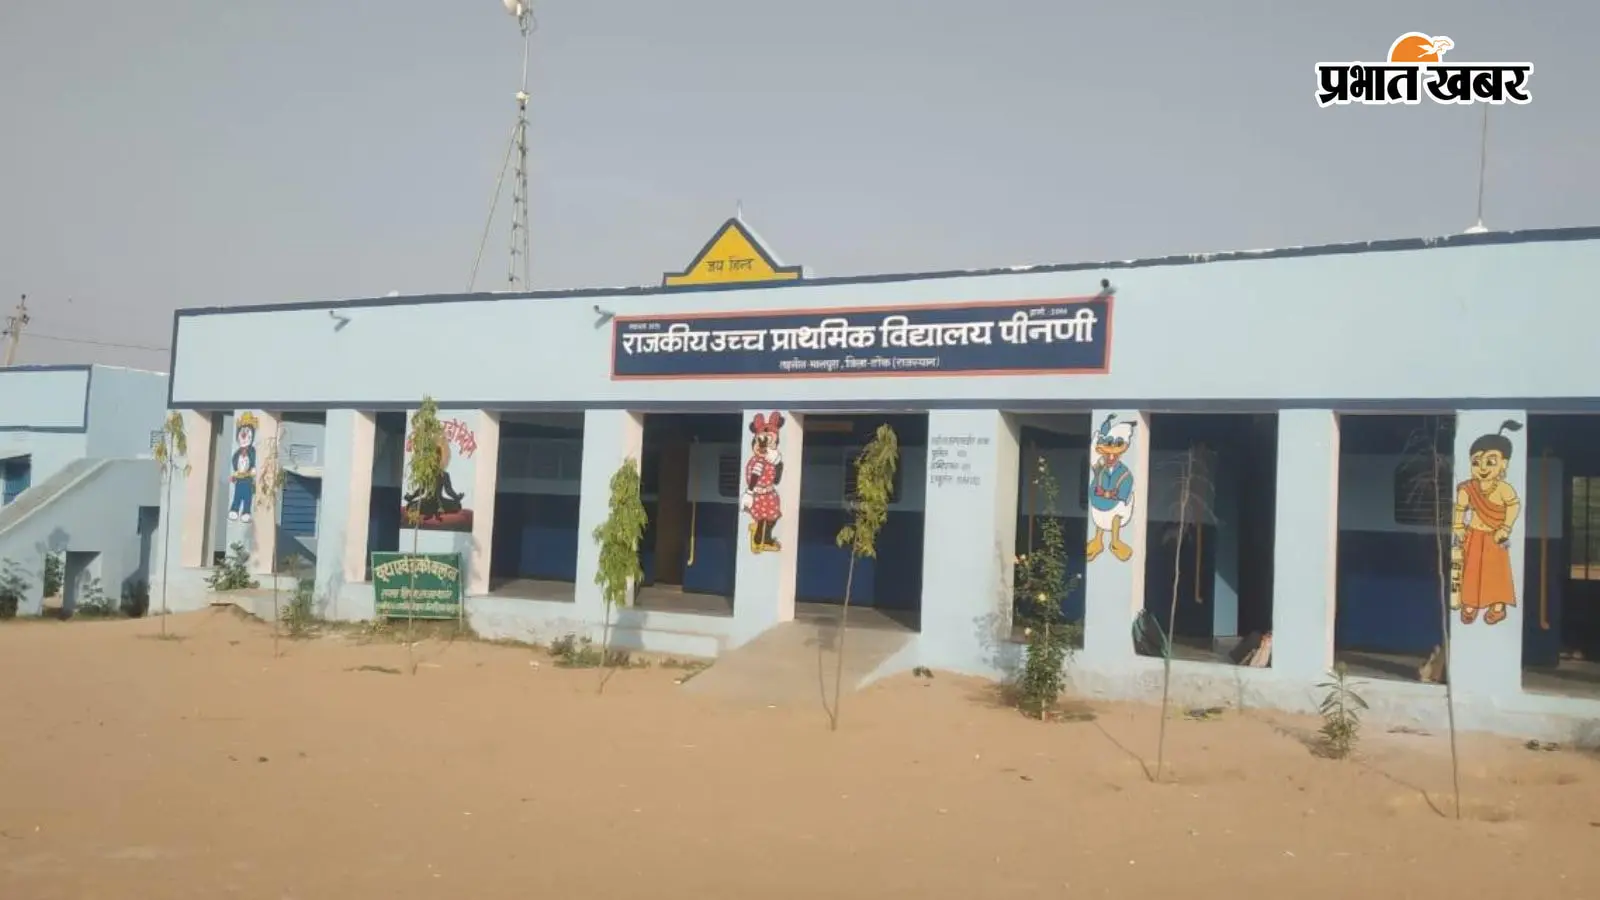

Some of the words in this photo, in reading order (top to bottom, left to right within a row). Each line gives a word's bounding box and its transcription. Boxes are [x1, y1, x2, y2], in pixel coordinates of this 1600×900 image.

[704, 259, 724, 273] जय
[622, 323, 710, 355] राजकीय
[710, 329, 767, 351] उच्च
[770, 318, 877, 352] प्राथमिक
[879, 315, 995, 348] विद्यालय
[998, 308, 1097, 344] पीनणी
